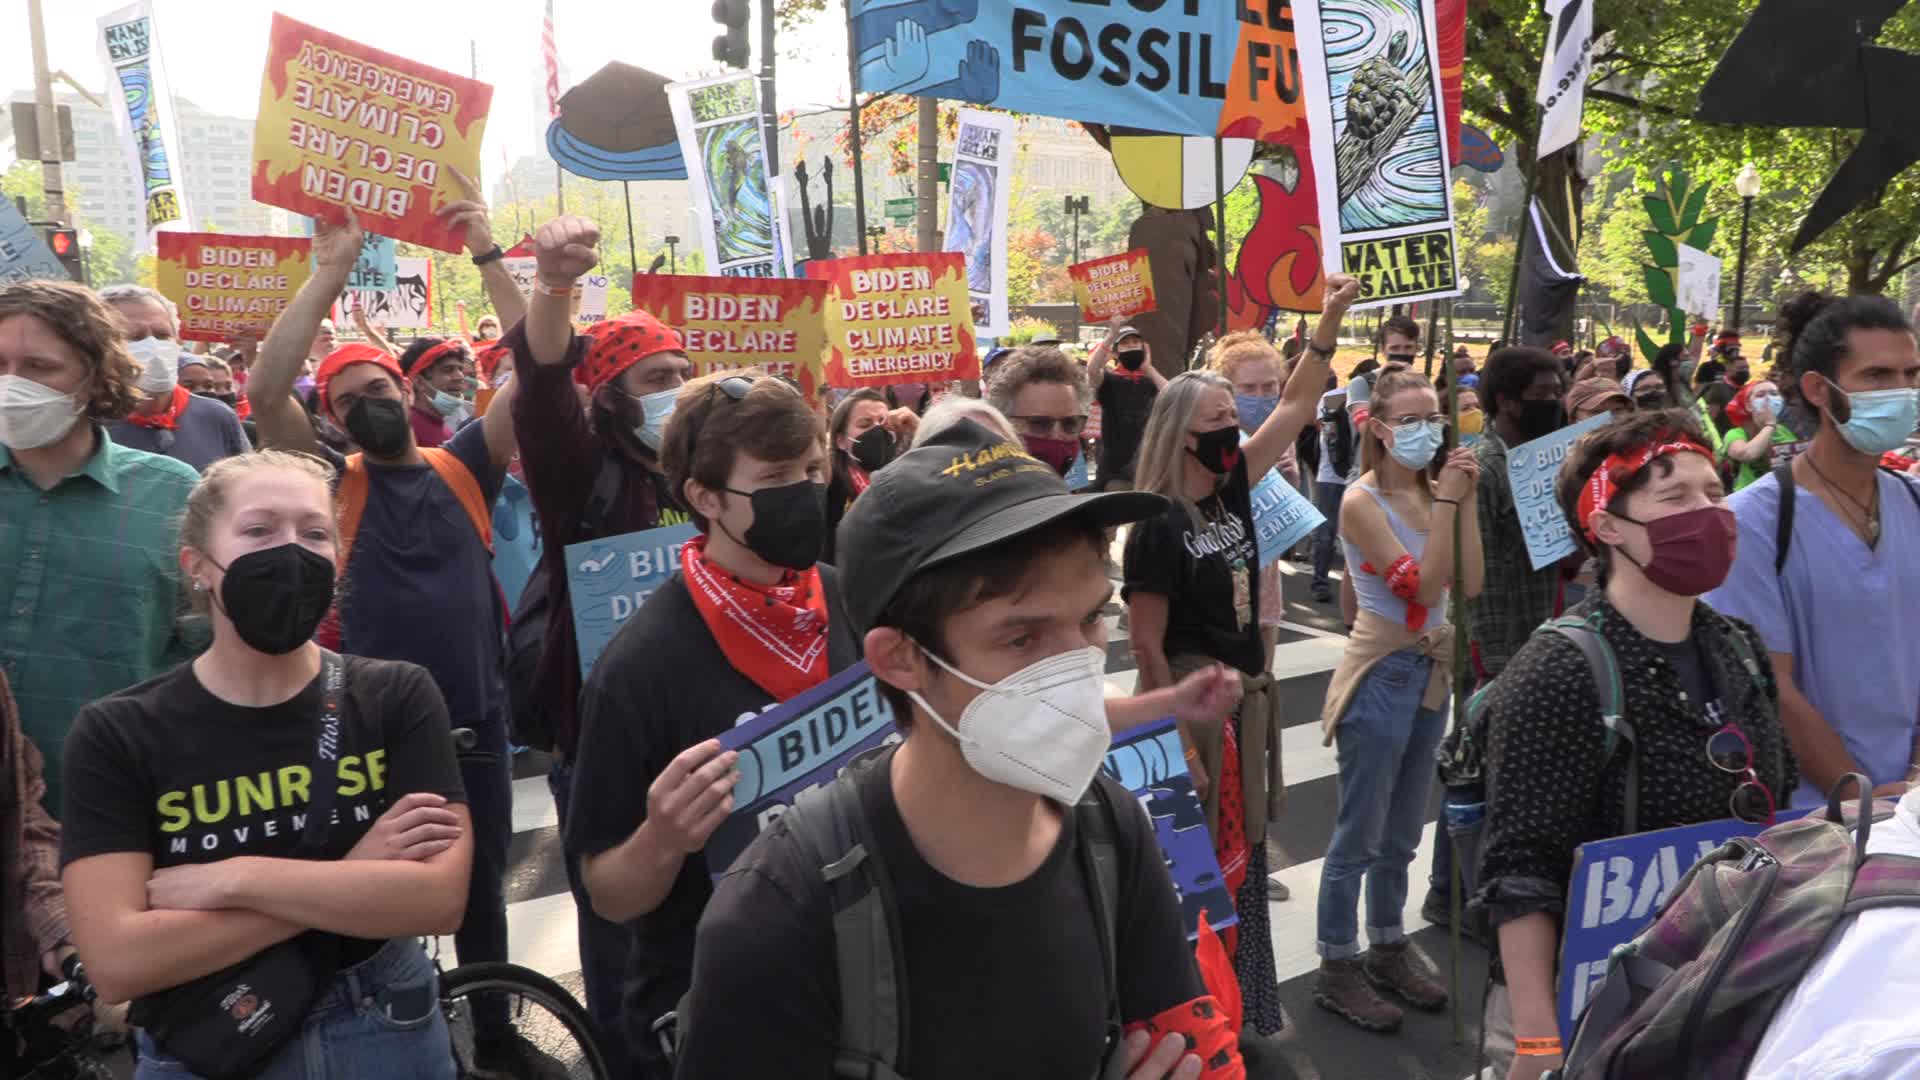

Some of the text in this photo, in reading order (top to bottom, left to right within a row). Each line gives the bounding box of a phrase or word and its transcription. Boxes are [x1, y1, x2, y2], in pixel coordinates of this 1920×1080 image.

[1011, 7, 1228, 100] FOSSIL
[300, 42, 453, 113] EMERGENCY
[295, 79, 445, 150] CLIMATE
[290, 118, 437, 187] DECLARE
[304, 161, 411, 217] BIDEN
[201, 247, 277, 267] BIDEN
[1344, 233, 1451, 273] WATER
[184, 271, 289, 290] DECLARE
[346, 271, 385, 288] LIFE
[853, 270, 932, 294] BIDEN
[1088, 260, 1130, 279] BIDEN
[1378, 263, 1453, 296] ALIVE
[186, 293, 288, 314] CLIMATE
[684, 294, 782, 322] BIDEN
[841, 295, 951, 322] DECLARE
[846, 324, 954, 351] CLIMATE
[849, 352, 954, 376] EMERGENCY
[156, 748, 387, 834] SUNRSE
[169, 799, 386, 855] MOVEMEN
